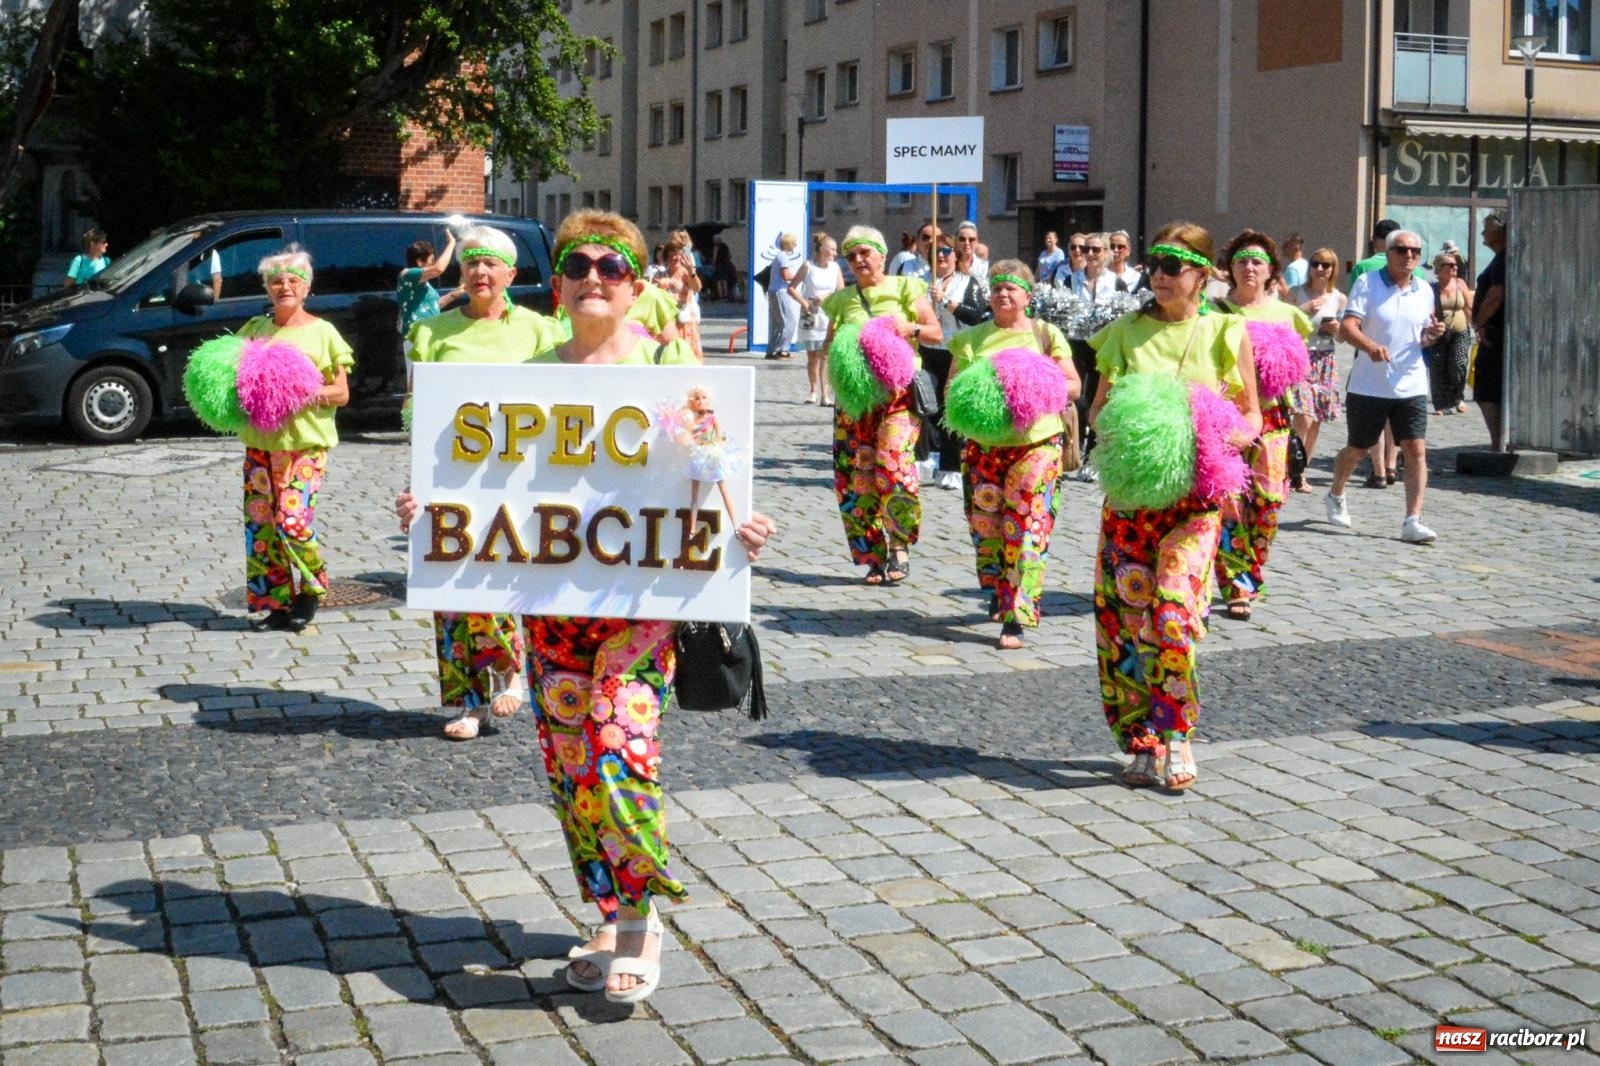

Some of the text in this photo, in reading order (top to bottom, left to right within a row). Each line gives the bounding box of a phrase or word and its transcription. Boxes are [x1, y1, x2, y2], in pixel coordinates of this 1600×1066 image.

[893, 144, 977, 158] SPEC MAMY
[1393, 138, 1550, 188] STELLA
[452, 401, 651, 467] SPEC
[423, 502, 723, 572] BABCIE
